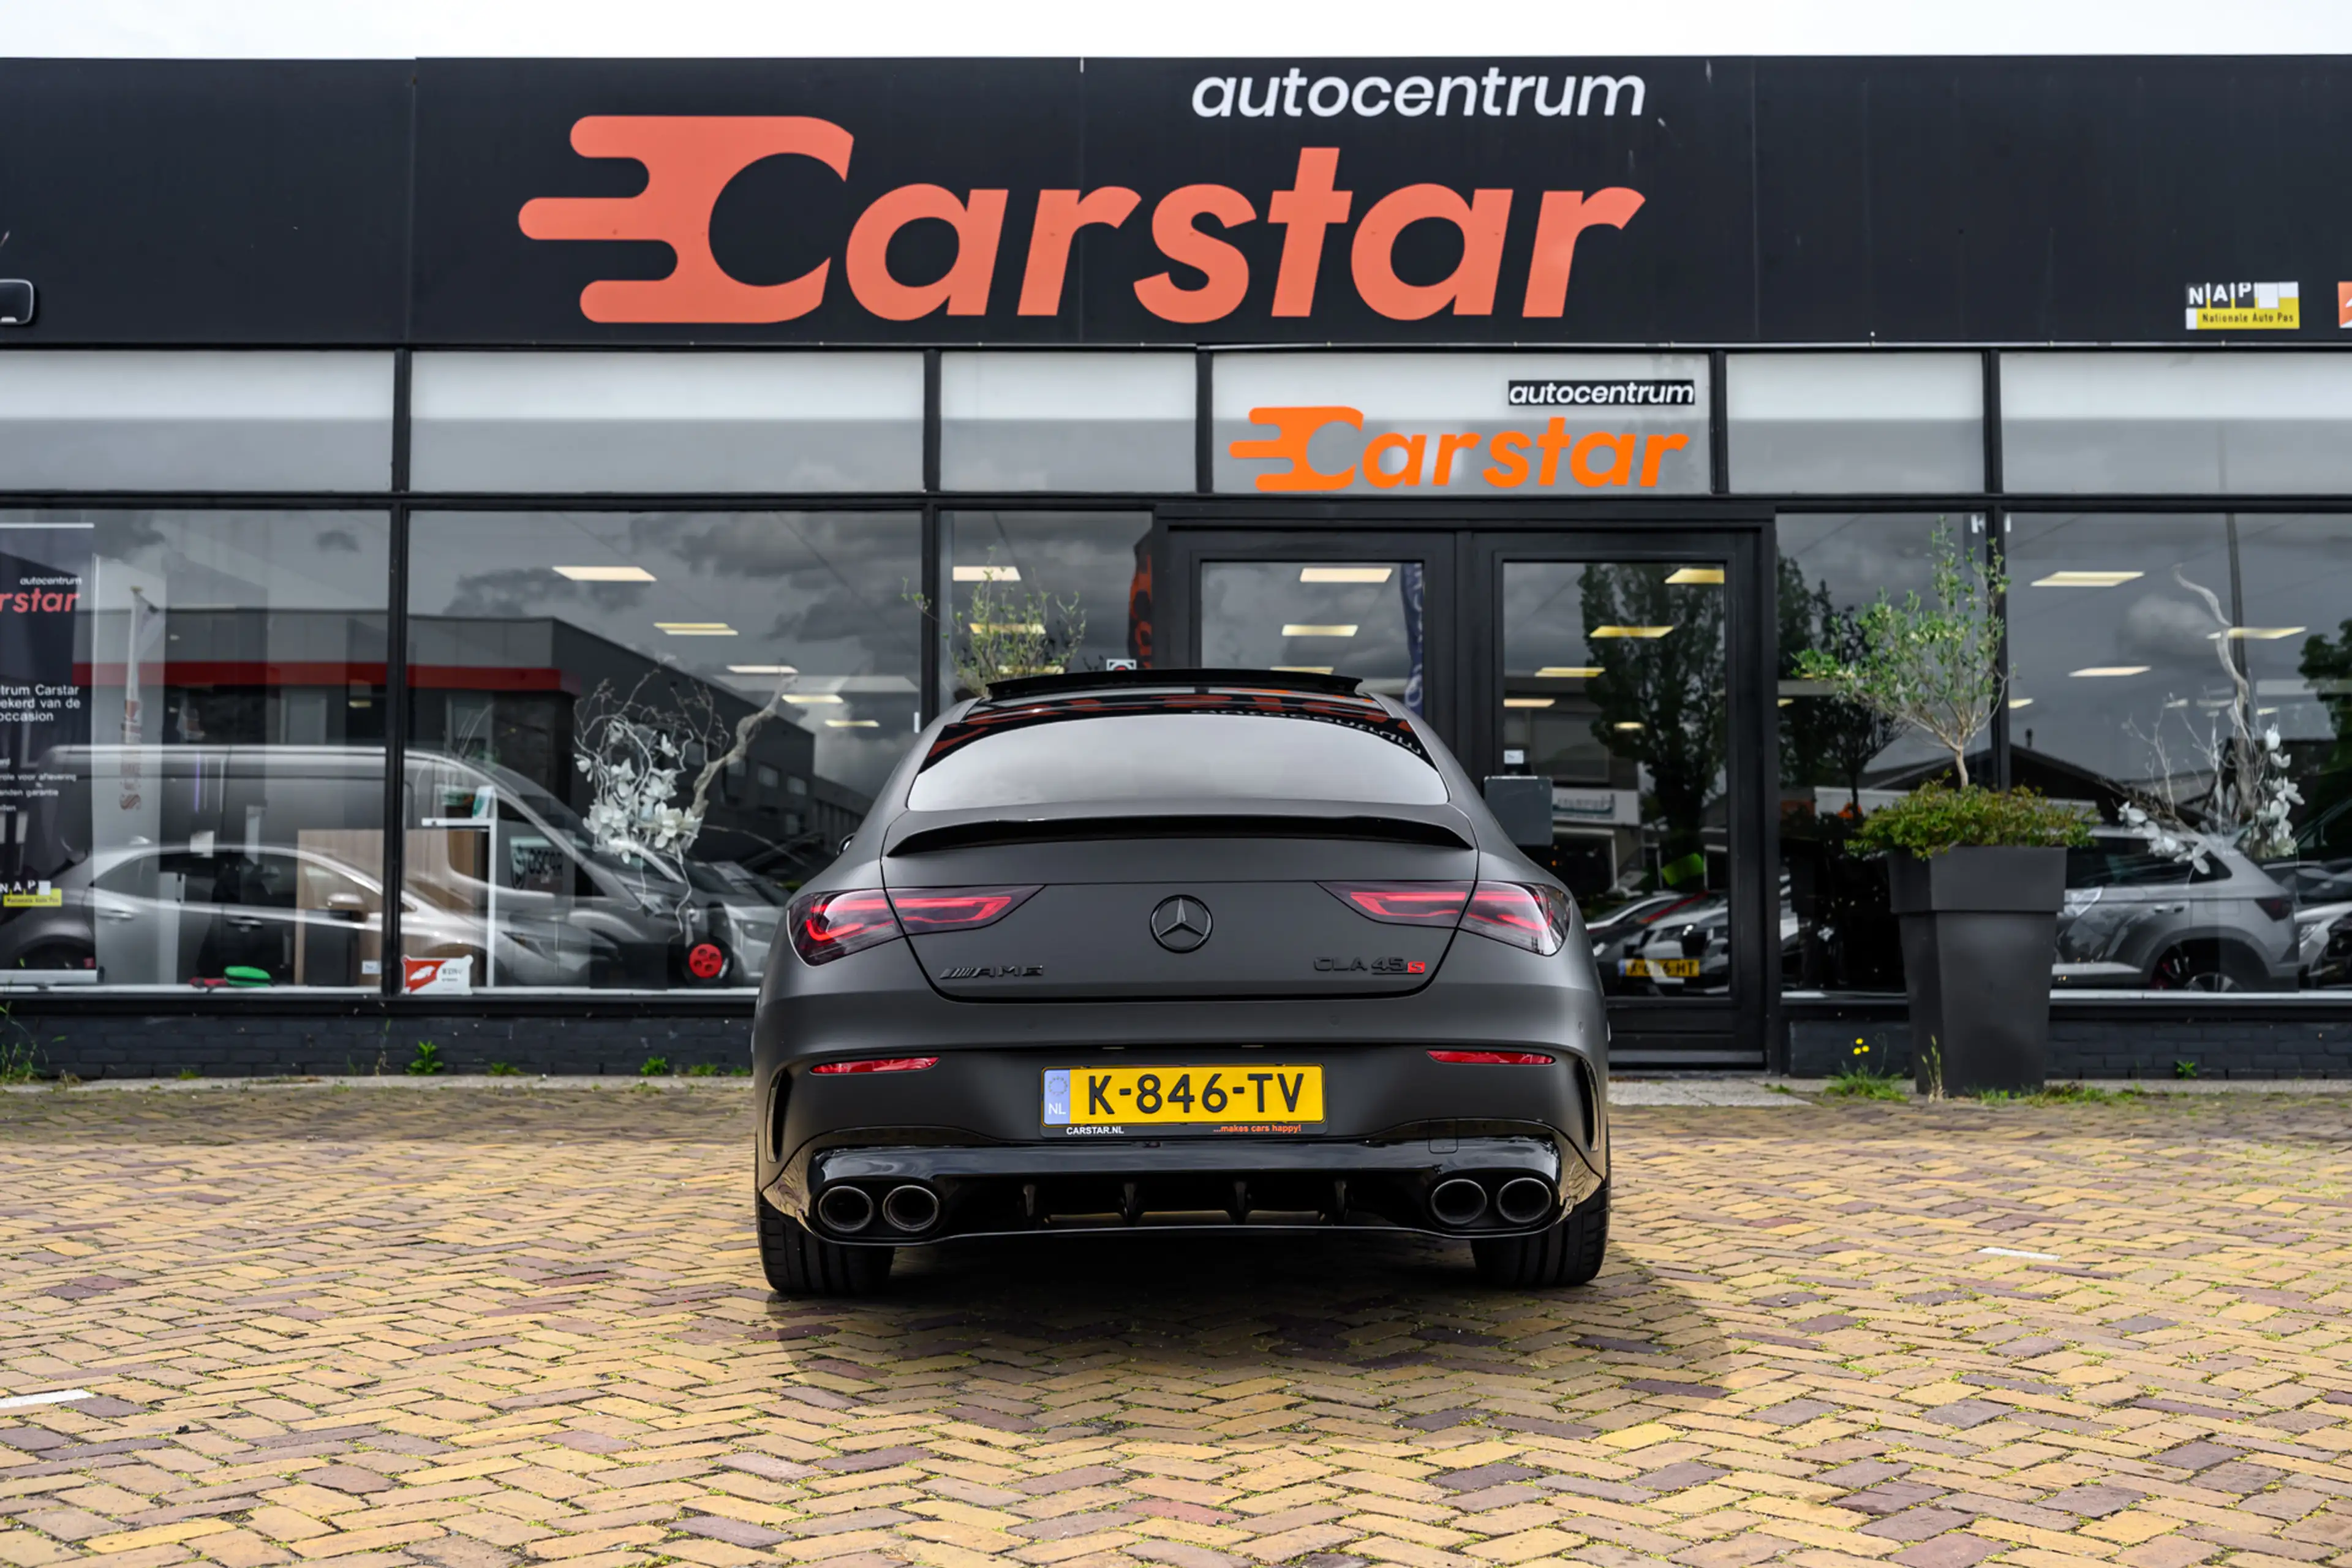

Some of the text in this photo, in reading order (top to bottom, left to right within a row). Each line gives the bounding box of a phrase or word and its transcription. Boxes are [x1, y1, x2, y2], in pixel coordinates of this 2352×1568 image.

[1193, 67, 1646, 119] autocentrum
[519, 115, 1646, 323] Carstar
[2188, 282, 2252, 305] NAP
[2202, 312, 2294, 323] Nationale Auto Pas
[1509, 381, 1695, 405] autocentrum
[1229, 406, 1691, 492] Carstar
[20, 576, 83, 586] autocentrum
[35, 684, 79, 696] Carstar
[40, 699, 61, 709] van
[65, 697, 81, 709] de
[1314, 957, 1368, 971] CLA
[1048, 1073, 1305, 1115] NL K-846-TV
[1066, 1126, 1125, 1136] CARSTAR.NL
[1272, 1125, 1302, 1134] happy!
